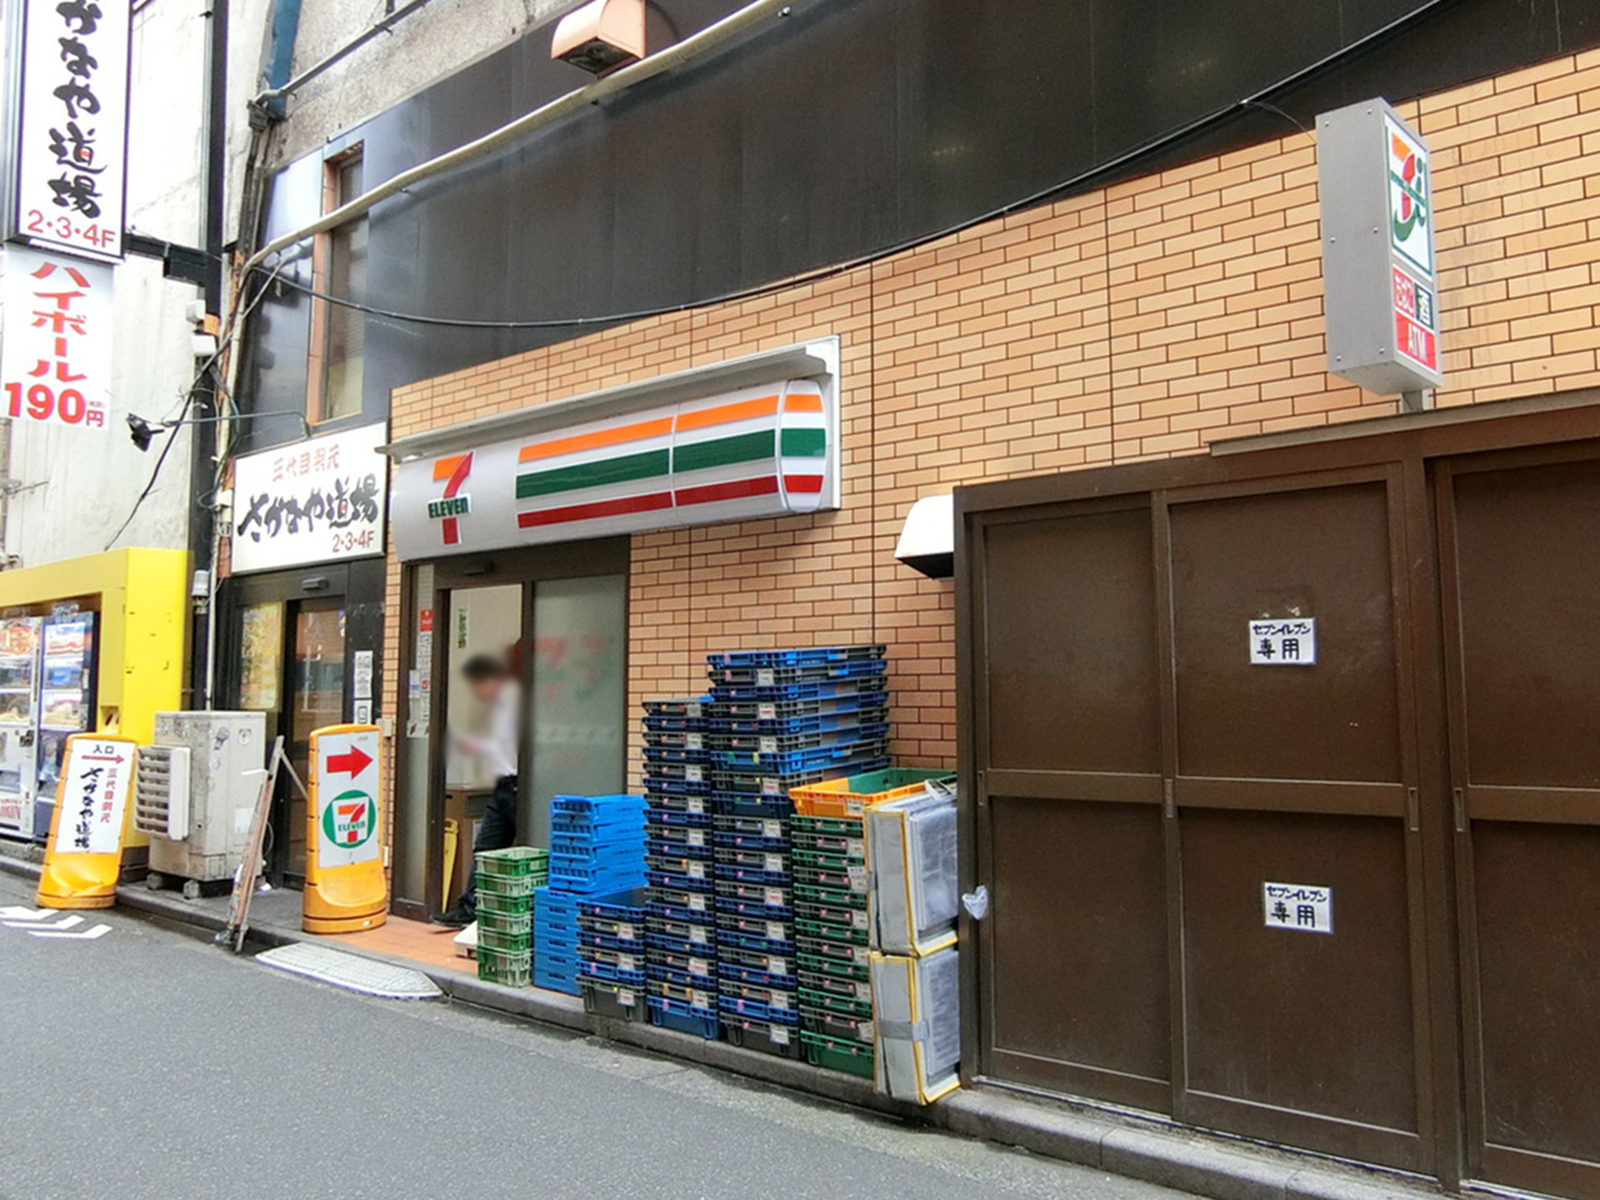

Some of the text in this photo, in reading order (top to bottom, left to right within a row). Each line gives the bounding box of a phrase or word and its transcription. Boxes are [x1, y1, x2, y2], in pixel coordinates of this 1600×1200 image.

[27, 261, 91, 383] ハイボール
[237, 473, 380, 543] さかなや道場
[1252, 622, 1311, 636] セブンイレブン
[93, 744, 115, 755] 入口
[1266, 885, 1327, 903] セブンイレブン
